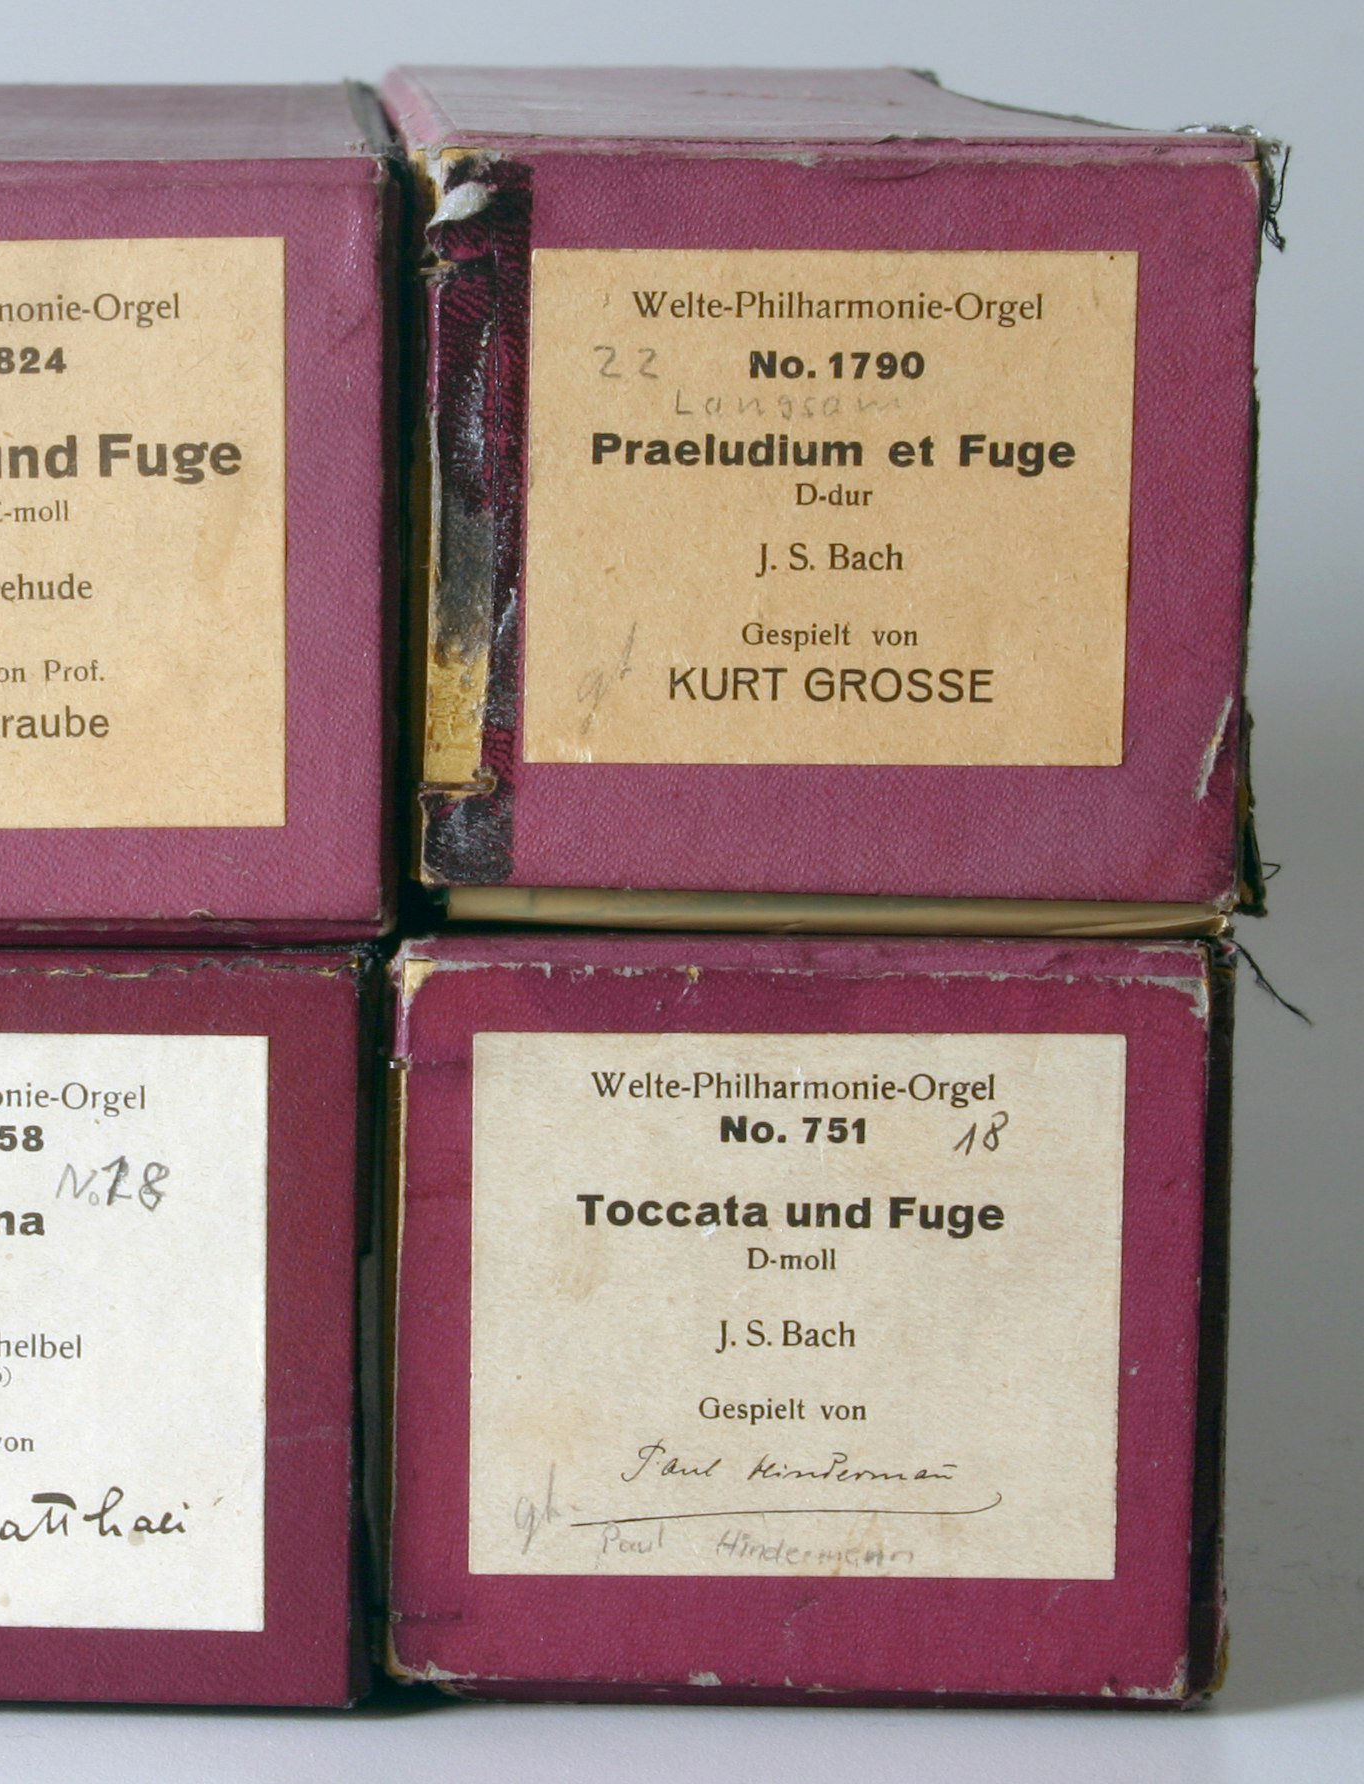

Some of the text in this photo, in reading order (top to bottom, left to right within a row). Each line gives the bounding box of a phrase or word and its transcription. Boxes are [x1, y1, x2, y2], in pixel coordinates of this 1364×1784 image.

[632, 291, 1042, 327] Welte-Philharmonie-Orgel
[750, 351, 924, 379] No. 1790
[99, 434, 242, 484] Fuge
[592, 433, 1075, 477] Praeludium et Fuge
[796, 483, 873, 506] D-dur
[756, 543, 903, 577] J. S. Bach
[742, 623, 917, 652] Gespielt von
[44, 660, 104, 682] Prof.
[670, 667, 993, 703] KURT GROSSE
[591, 1072, 994, 1108] Welte-Philharmonie-Orgel
[721, 1116, 865, 1144] No. 751
[952, 1110, 1011, 1158] 18
[577, 1194, 1004, 1239] Toccata und Fuge
[747, 1248, 836, 1270] D-moll
[716, 1320, 855, 1353] J. S. Bach
[699, 1397, 866, 1425] Gespielt von
[621, 1438, 723, 1484] Paul
